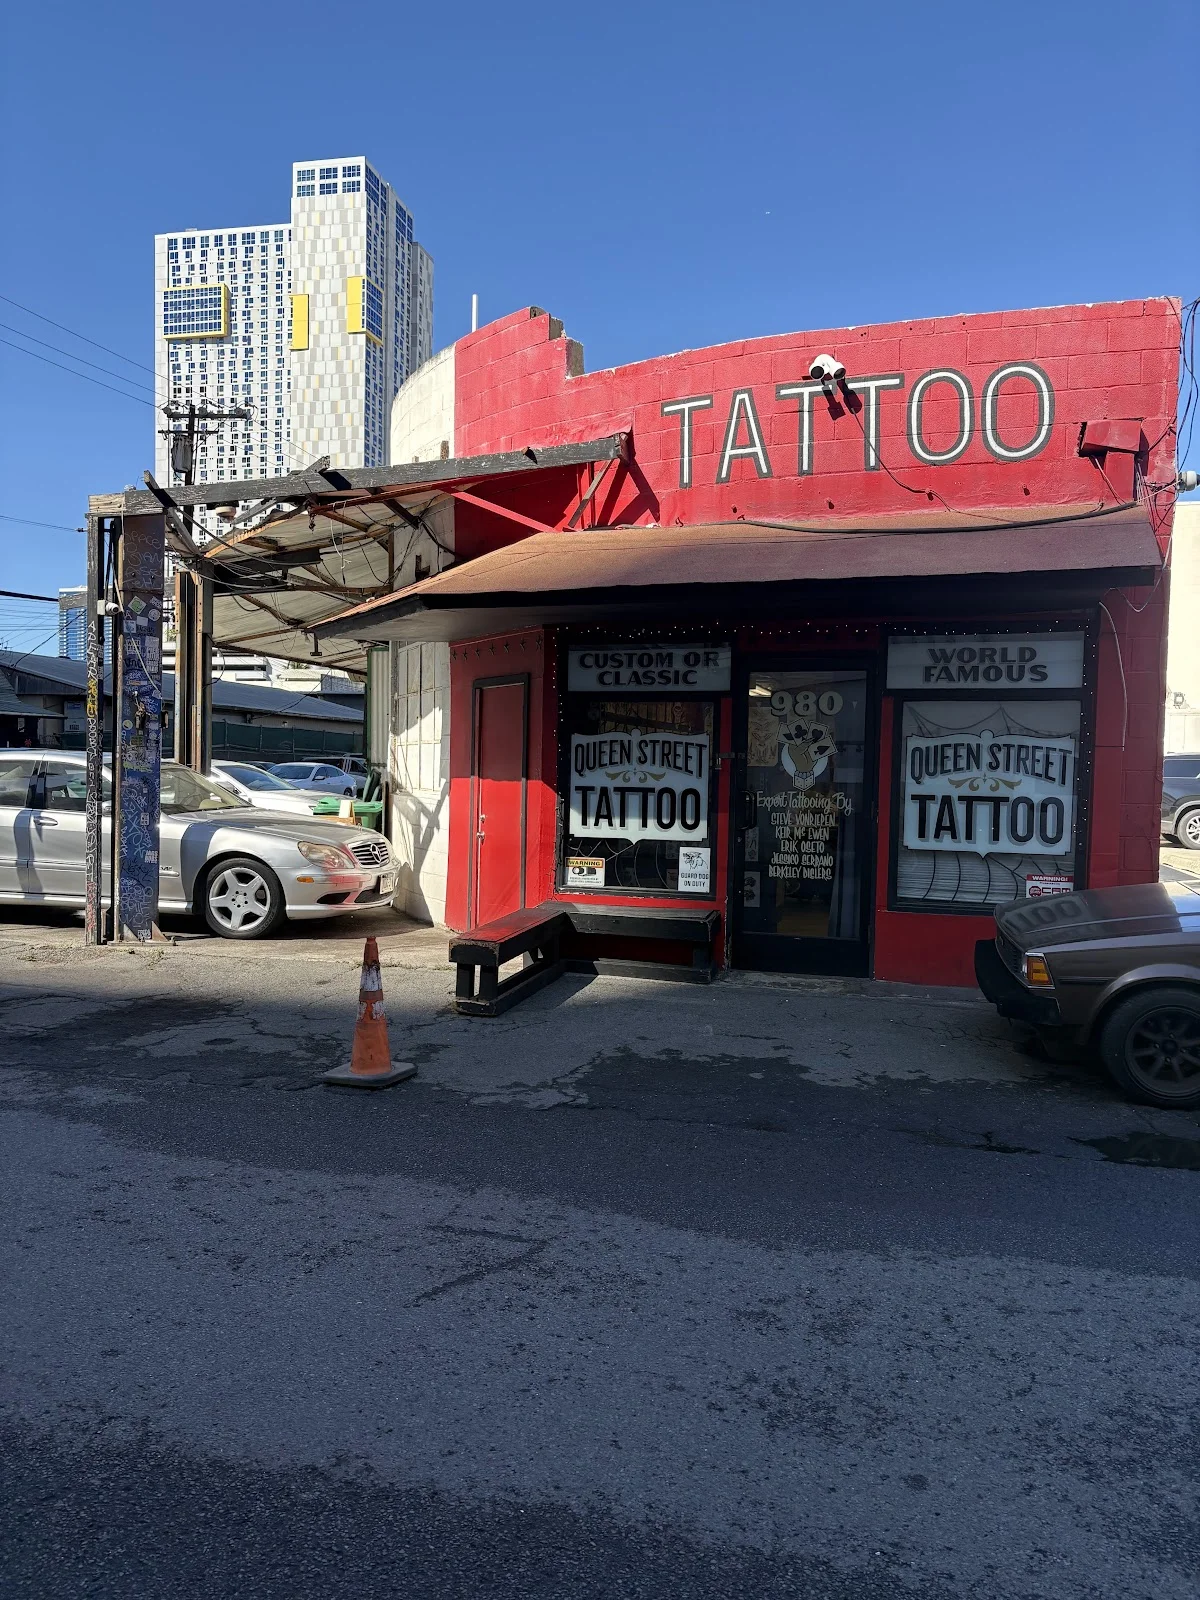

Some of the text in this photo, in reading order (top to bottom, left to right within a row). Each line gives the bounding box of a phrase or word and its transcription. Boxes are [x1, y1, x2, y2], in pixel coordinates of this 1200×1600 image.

[660, 361, 1056, 490] TATTOO
[577, 651, 720, 669] CUSTOM OR
[927, 646, 1037, 664] WORLD
[596, 669, 697, 686] CLASSIC
[923, 664, 1049, 683] FAMOUS
[770, 690, 844, 717] 980
[574, 740, 708, 778] QUEEN STREET
[909, 743, 1073, 787] QUEEN STREET
[574, 786, 702, 831] TATTOO
[756, 790, 854, 816] Expert Tattooing By
[770, 810, 792, 825] STEVE
[910, 794, 1065, 845] TATTOO
[780, 839, 799, 853] ERIK
[768, 864, 802, 879] BERKELEY
